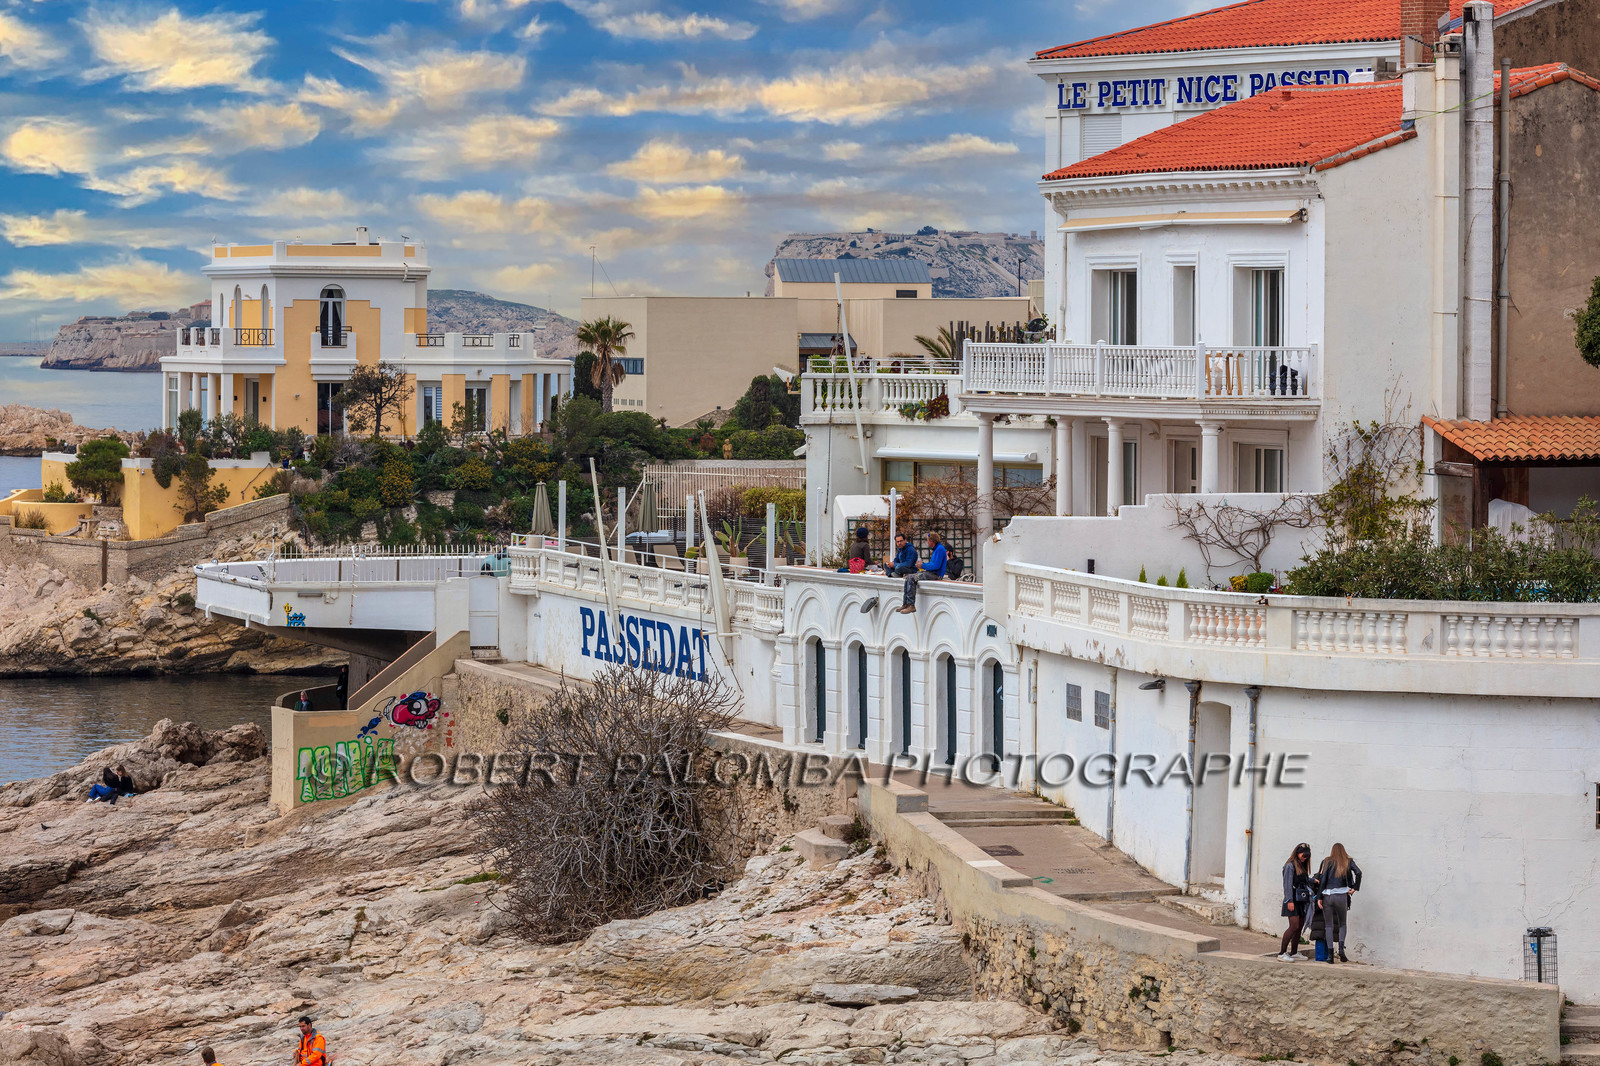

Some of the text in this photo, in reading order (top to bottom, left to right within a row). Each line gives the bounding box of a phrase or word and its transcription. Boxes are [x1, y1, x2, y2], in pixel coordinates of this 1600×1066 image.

[1057, 67, 1372, 110] LE PETIT NICE PASSED
[579, 606, 710, 684] PASSEDAT
